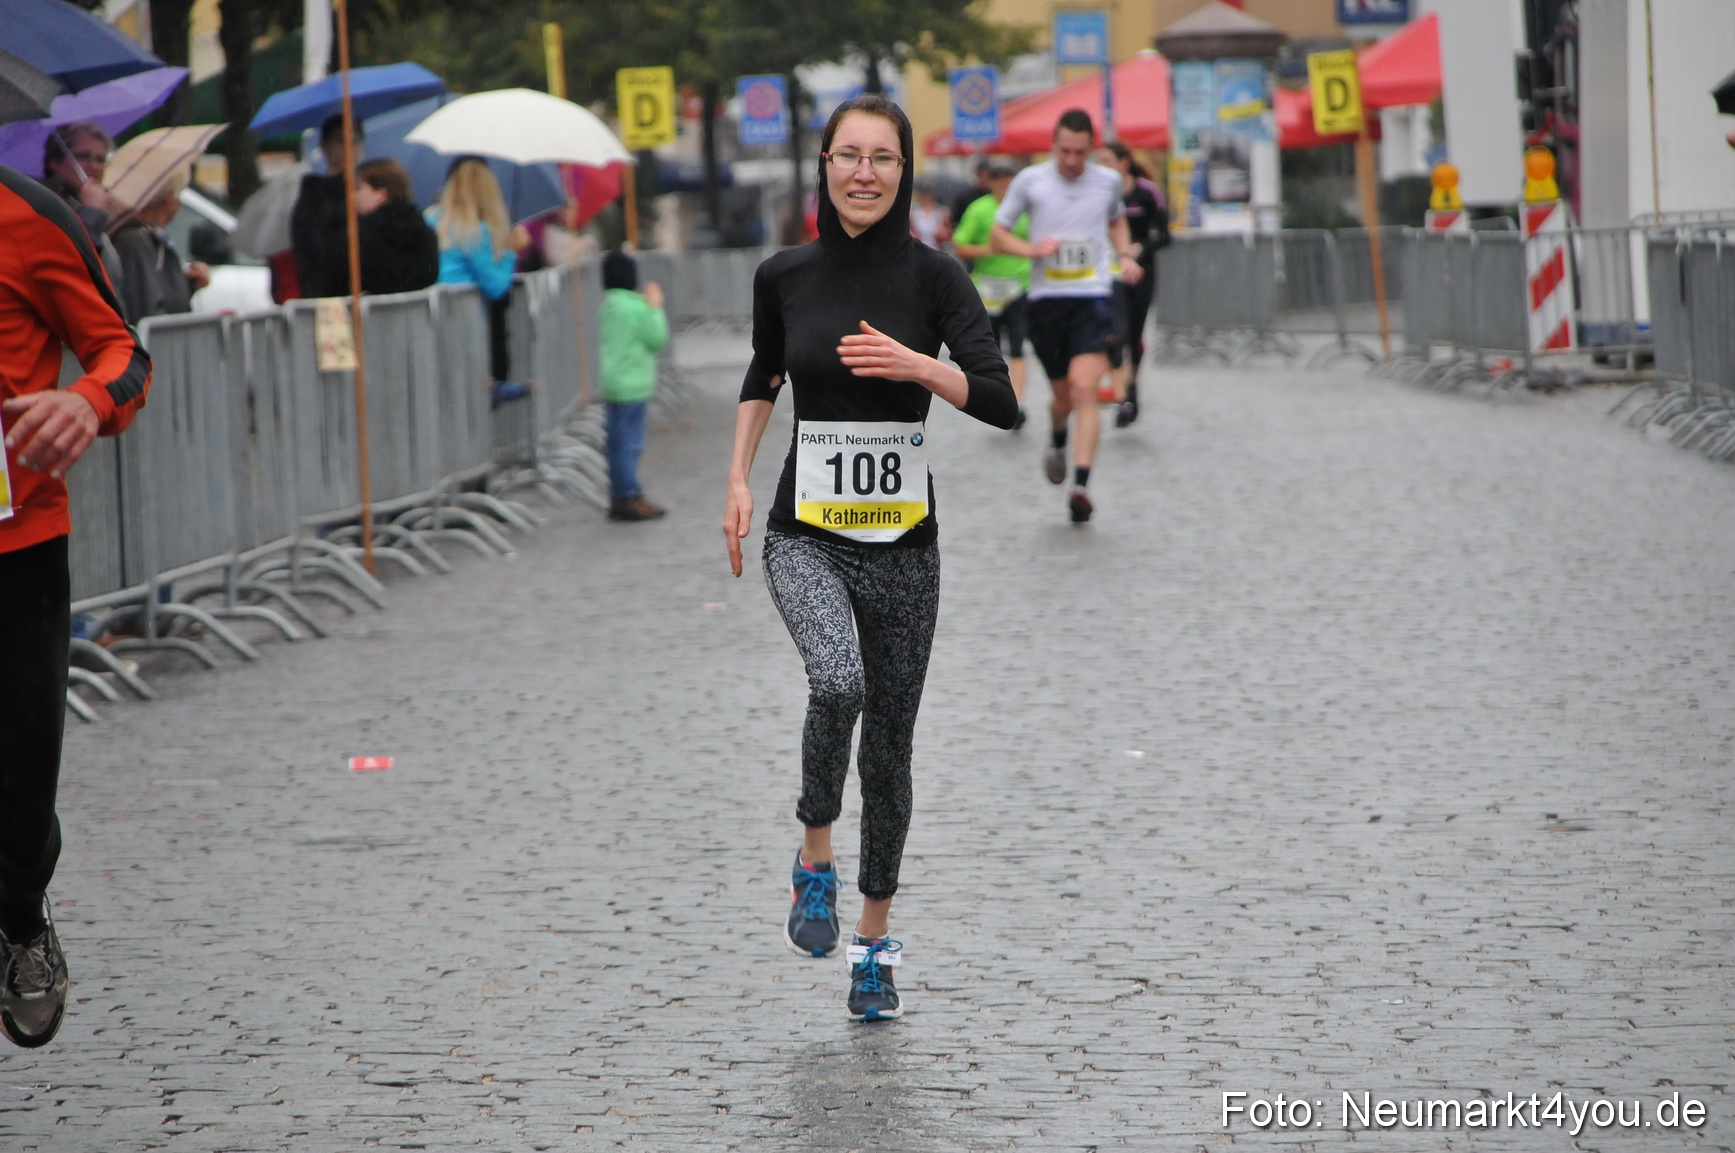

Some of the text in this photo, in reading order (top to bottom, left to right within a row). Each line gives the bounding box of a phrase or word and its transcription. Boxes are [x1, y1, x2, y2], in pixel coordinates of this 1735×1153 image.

[634, 93, 660, 128] D
[1324, 77, 1349, 112] D
[801, 433, 905, 445] PARTL Neumarkt
[825, 451, 902, 496] 108
[822, 507, 902, 525] Katharina
